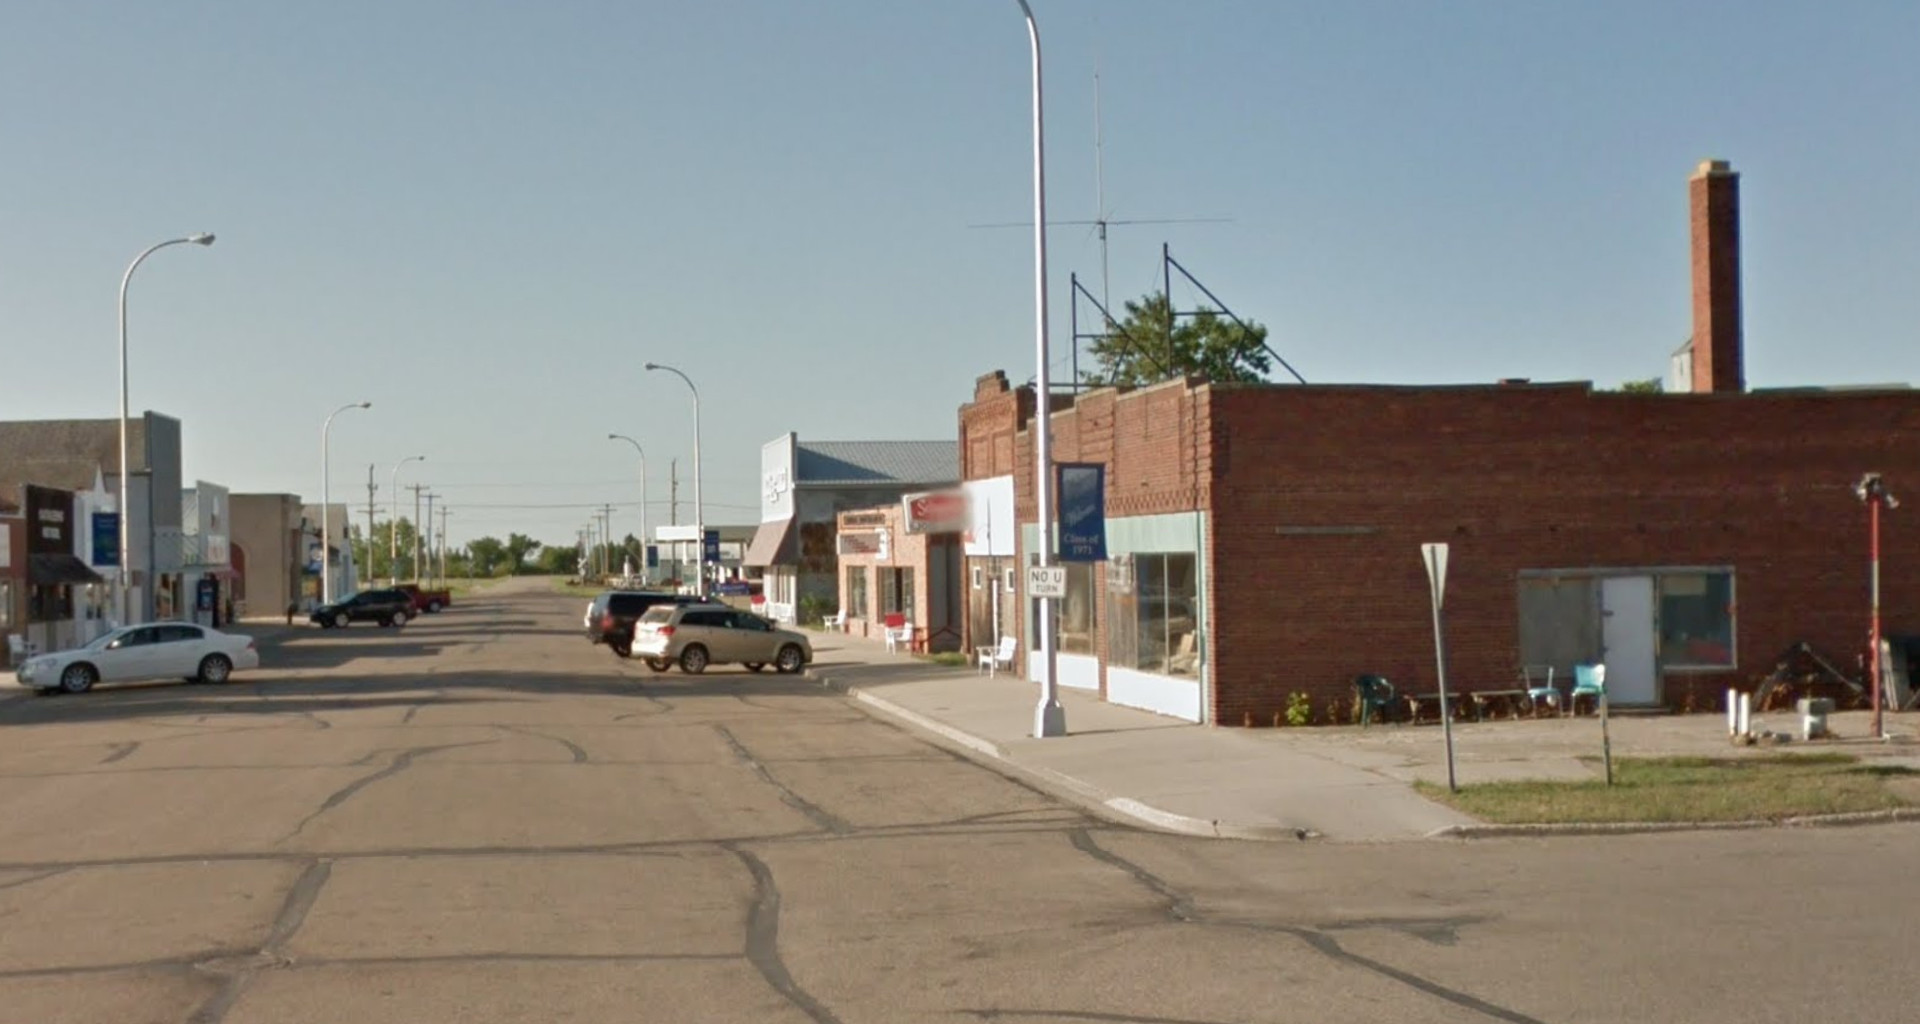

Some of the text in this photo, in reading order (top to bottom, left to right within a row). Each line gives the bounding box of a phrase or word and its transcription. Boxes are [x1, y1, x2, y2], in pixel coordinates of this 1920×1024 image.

[1064, 533, 1099, 545] Class of
[1031, 570, 1062, 583] NO U
[1036, 584, 1057, 592] TURN
